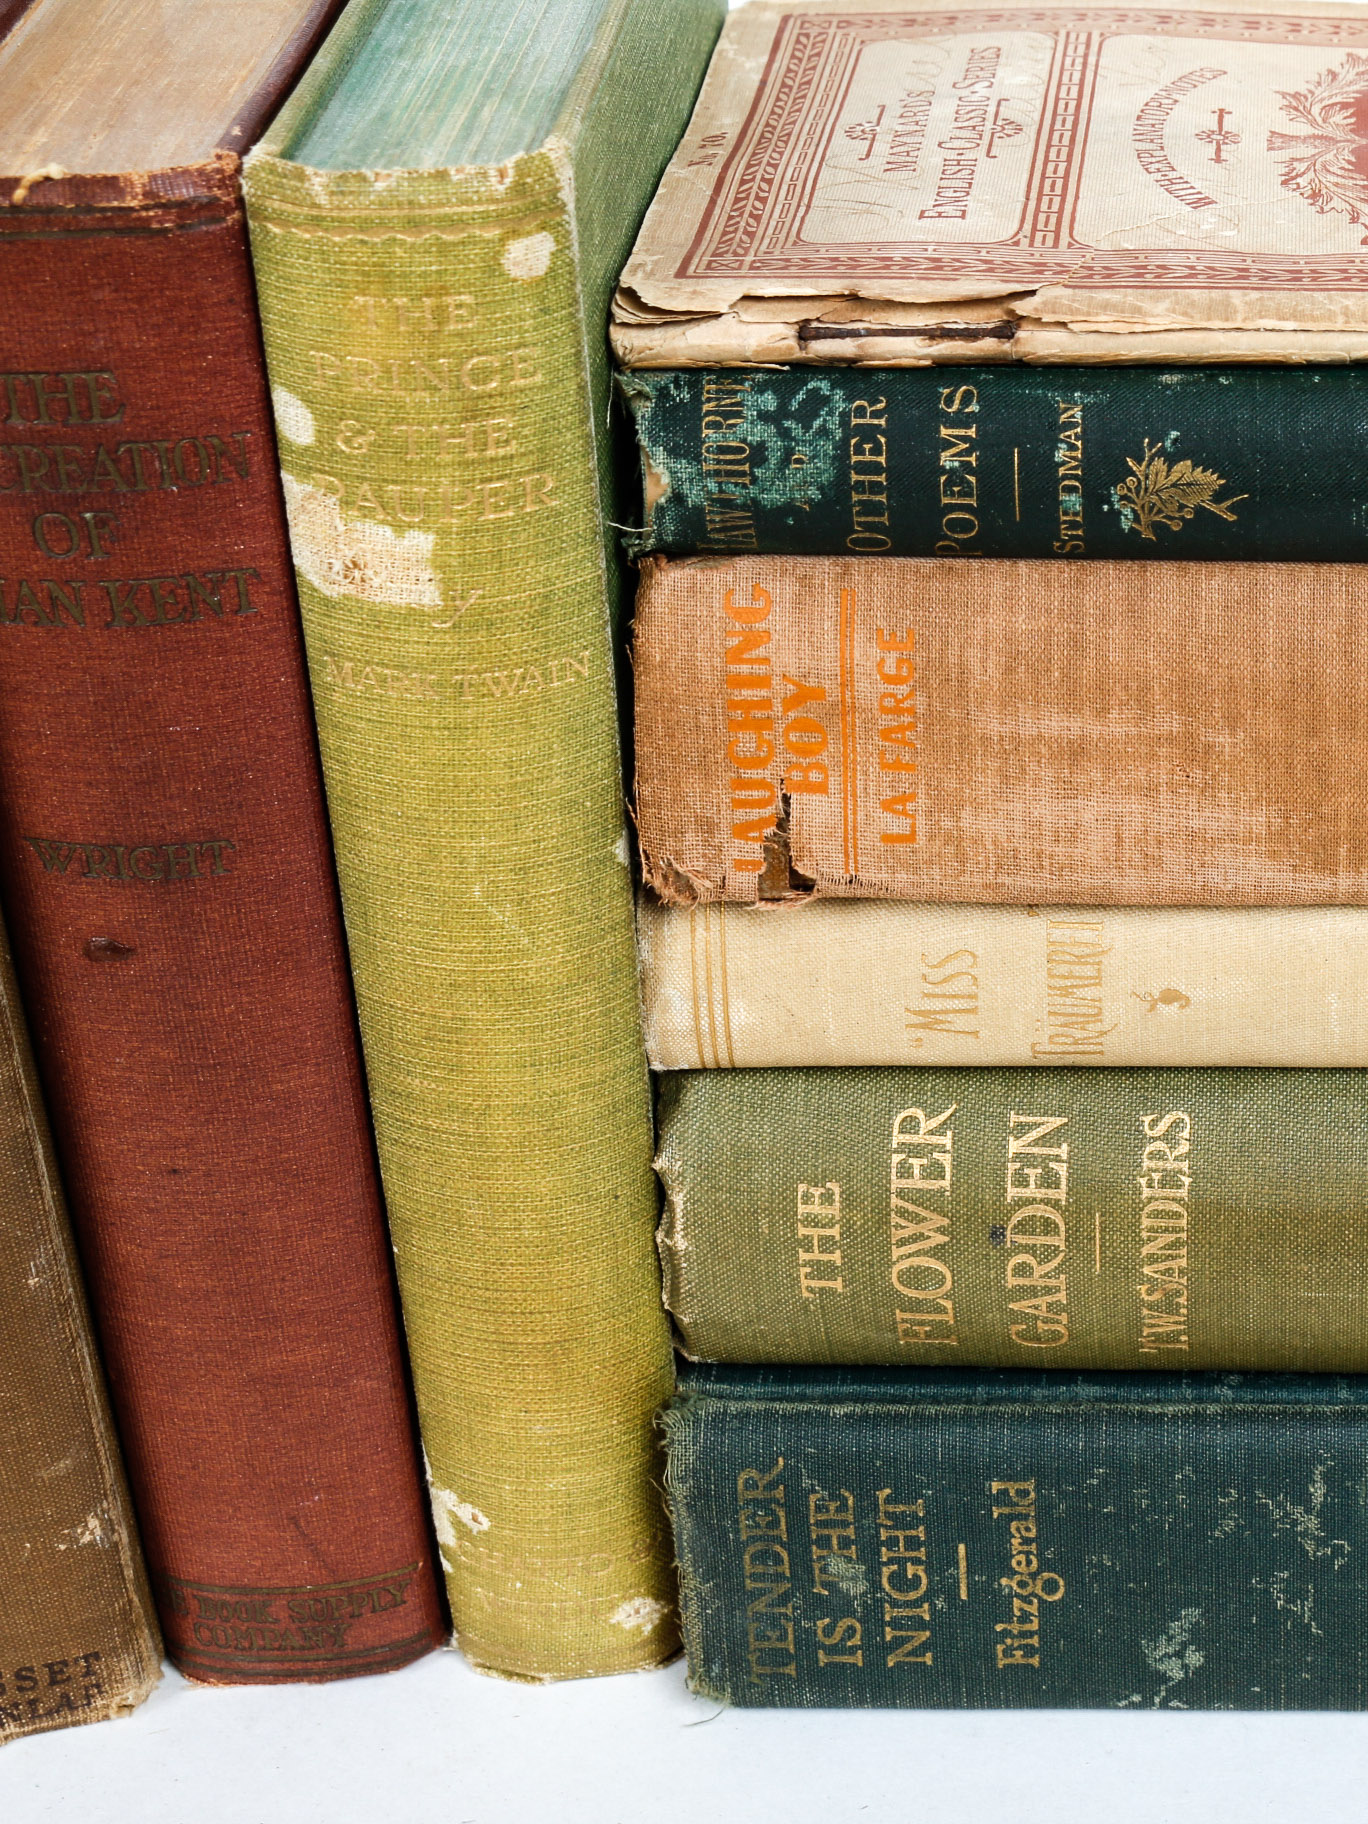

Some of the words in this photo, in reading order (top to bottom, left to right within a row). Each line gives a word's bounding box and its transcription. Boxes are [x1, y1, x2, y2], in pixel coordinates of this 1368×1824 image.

[354, 294, 478, 330] THE
[0, 371, 126, 425] THE
[309, 347, 542, 393] PRINCE
[336, 420, 376, 454] &
[393, 418, 517, 459] THE
[312, 473, 562, 523] PAUPER
[846, 396, 892, 551] OTHER
[935, 385, 983, 556] POEMS
[1053, 399, 1086, 554] STEDMAN
[33, 511, 121, 560] OF
[98, 567, 262, 628] KENT
[323, 656, 448, 699] MARK
[454, 649, 590, 699] TWAIN
[876, 628, 917, 774] FARGE
[782, 674, 829, 796] BOY
[880, 792, 917, 845] LA
[22, 836, 236, 880] WRIGHT
[797, 1181, 843, 1298] THE
[891, 1102, 960, 1345] FLOWER
[1006, 1110, 1069, 1347] GARDEN
[737, 1456, 797, 1684] TENDER
[809, 1489, 862, 1596] THE
[193, 1594, 281, 1625] BOOK
[288, 1578, 412, 1624] SUPPLY
[876, 1488, 934, 1668] NIGHT
[991, 1477, 1066, 1669] Fitzgerald
[193, 1621, 351, 1651] COMPANY
[817, 1616, 865, 1668] IS
[0, 1651, 101, 1696] SET
